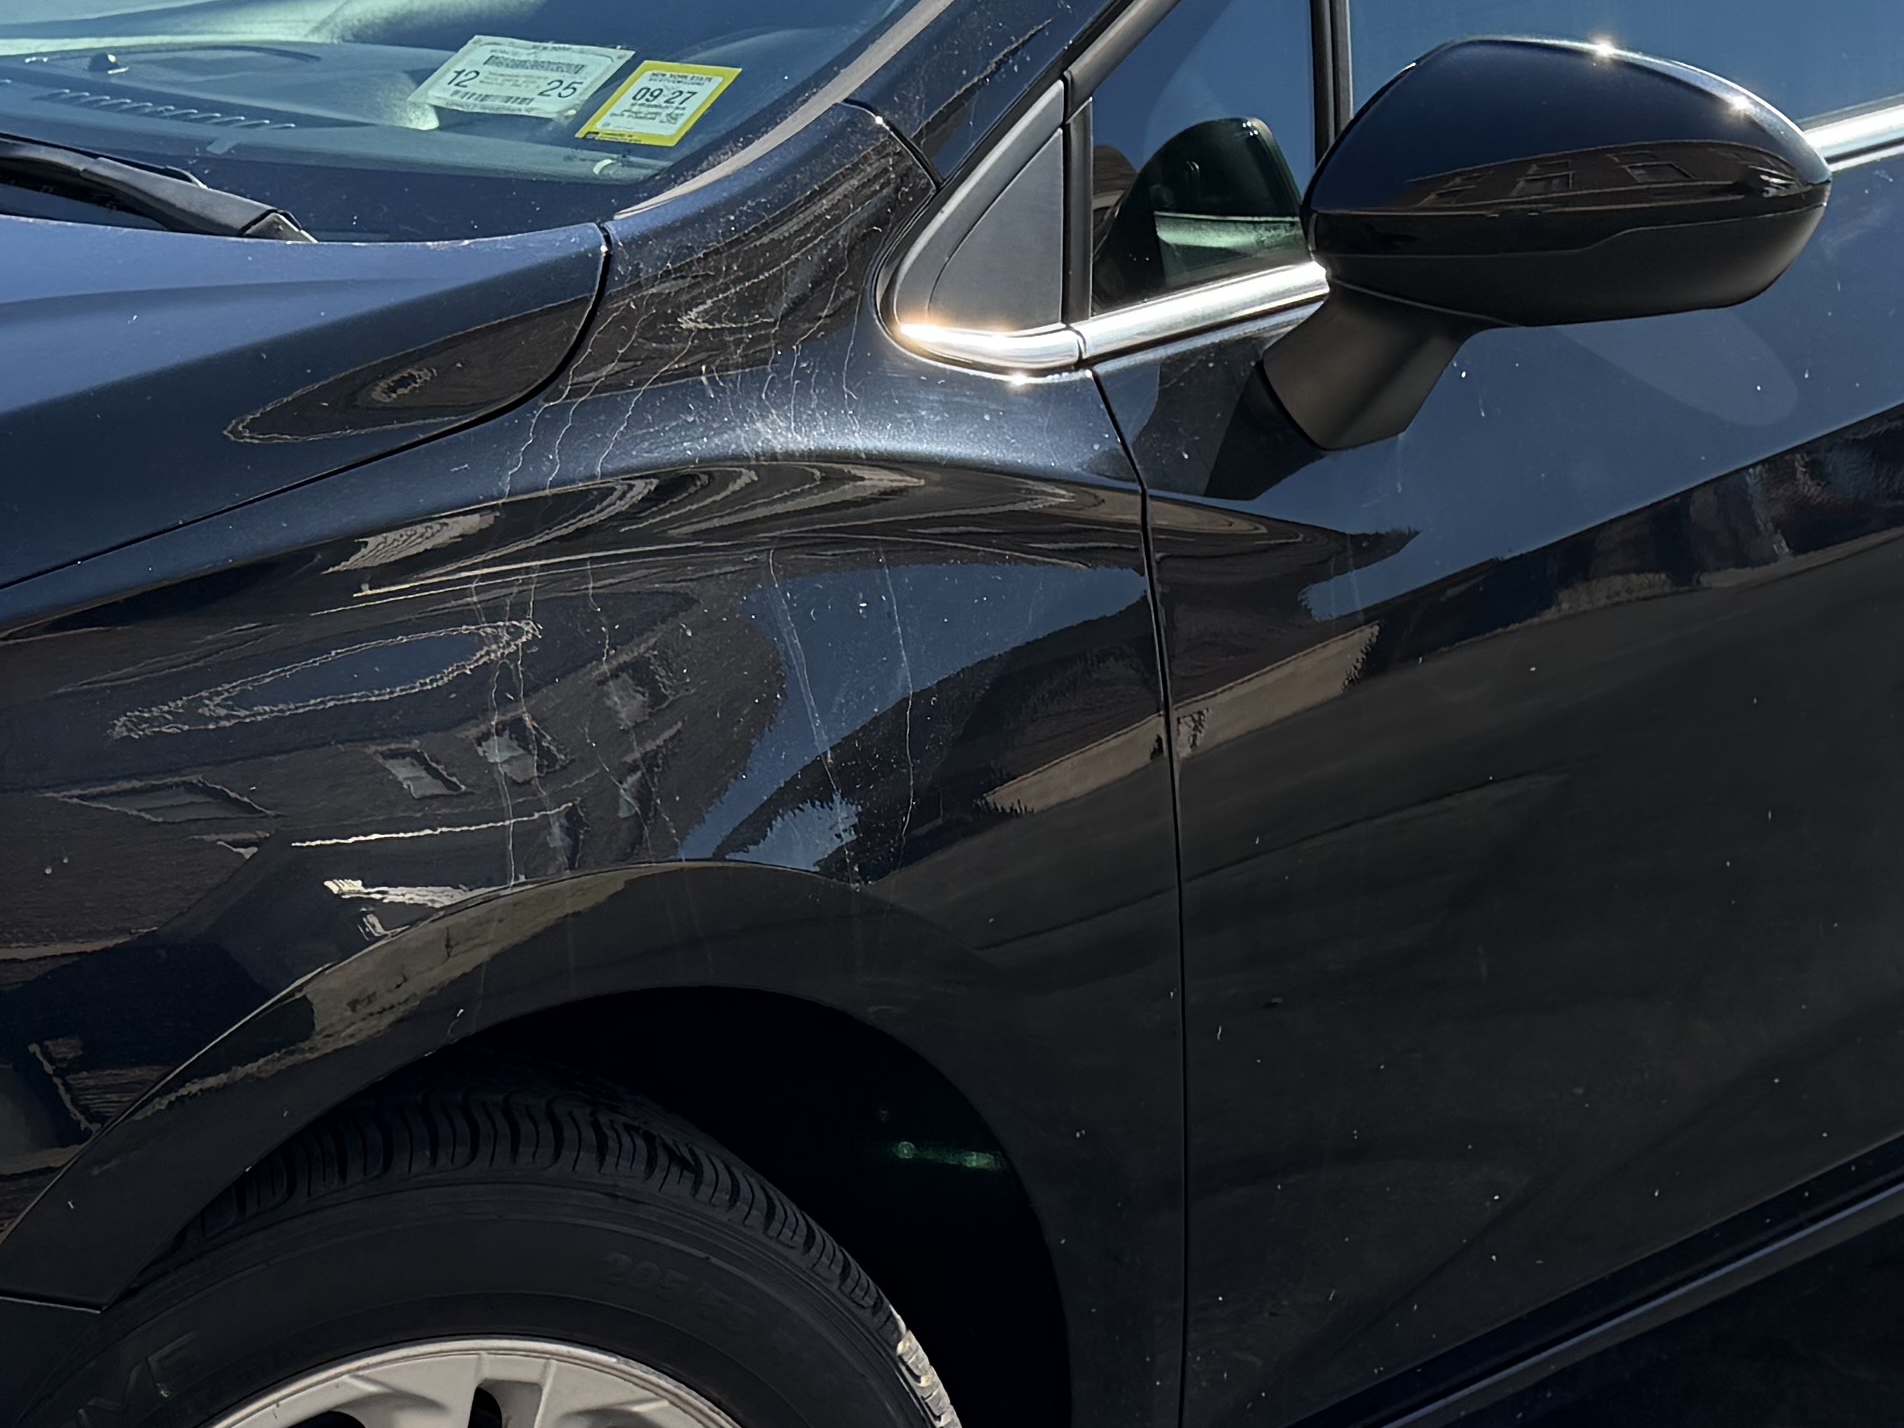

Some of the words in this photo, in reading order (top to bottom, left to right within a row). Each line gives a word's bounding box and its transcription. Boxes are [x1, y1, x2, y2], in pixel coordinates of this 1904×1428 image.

[446, 68, 480, 89] 12
[537, 79, 584, 99] 25
[632, 86, 664, 103] 09
[663, 89, 698, 106] 27
